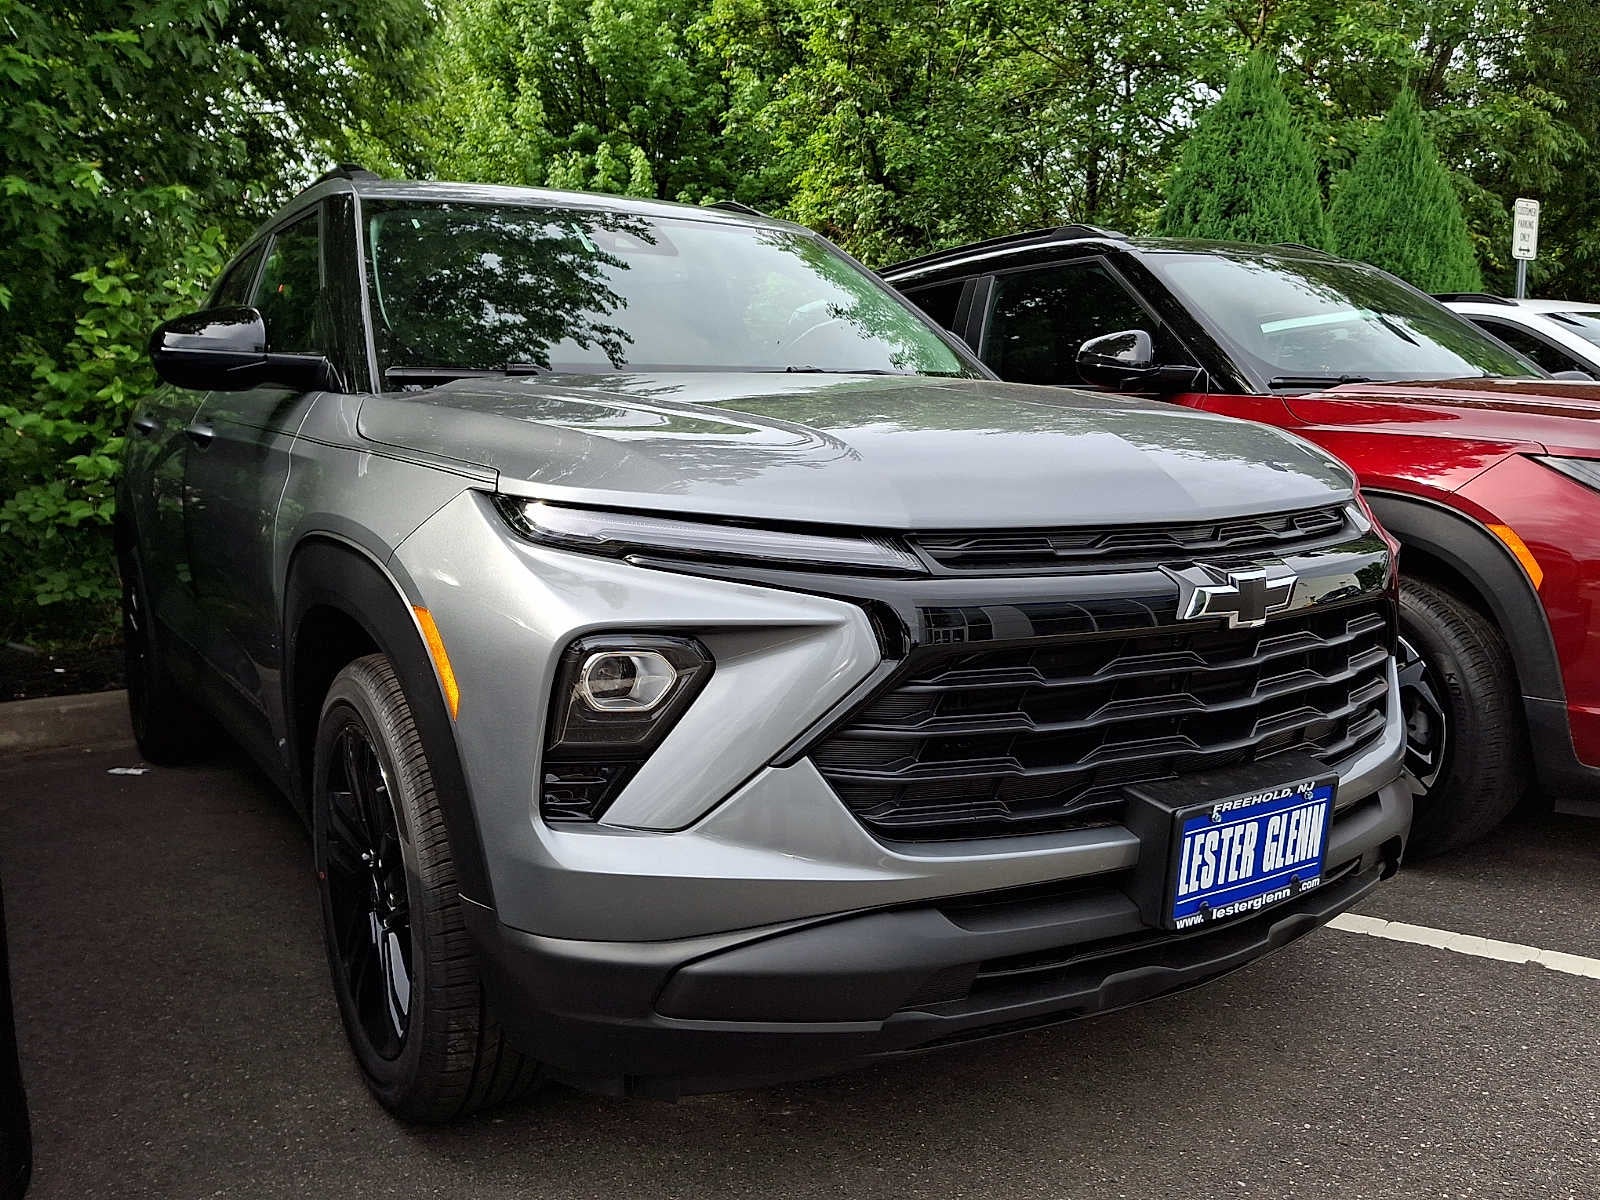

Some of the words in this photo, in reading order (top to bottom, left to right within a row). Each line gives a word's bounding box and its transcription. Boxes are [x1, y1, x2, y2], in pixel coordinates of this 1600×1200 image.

[1517, 218, 1534, 230] PARKING
[1519, 232, 1530, 242] ONLY
[1213, 788, 1294, 814] FREEHOLD,
[1297, 781, 1316, 793] NJ
[1178, 822, 1260, 896] LESTER
[1262, 803, 1327, 873] GLENN
[1176, 914, 1204, 930] www.
[1212, 888, 1291, 920] lesterglenn
[1299, 877, 1321, 892] .com
